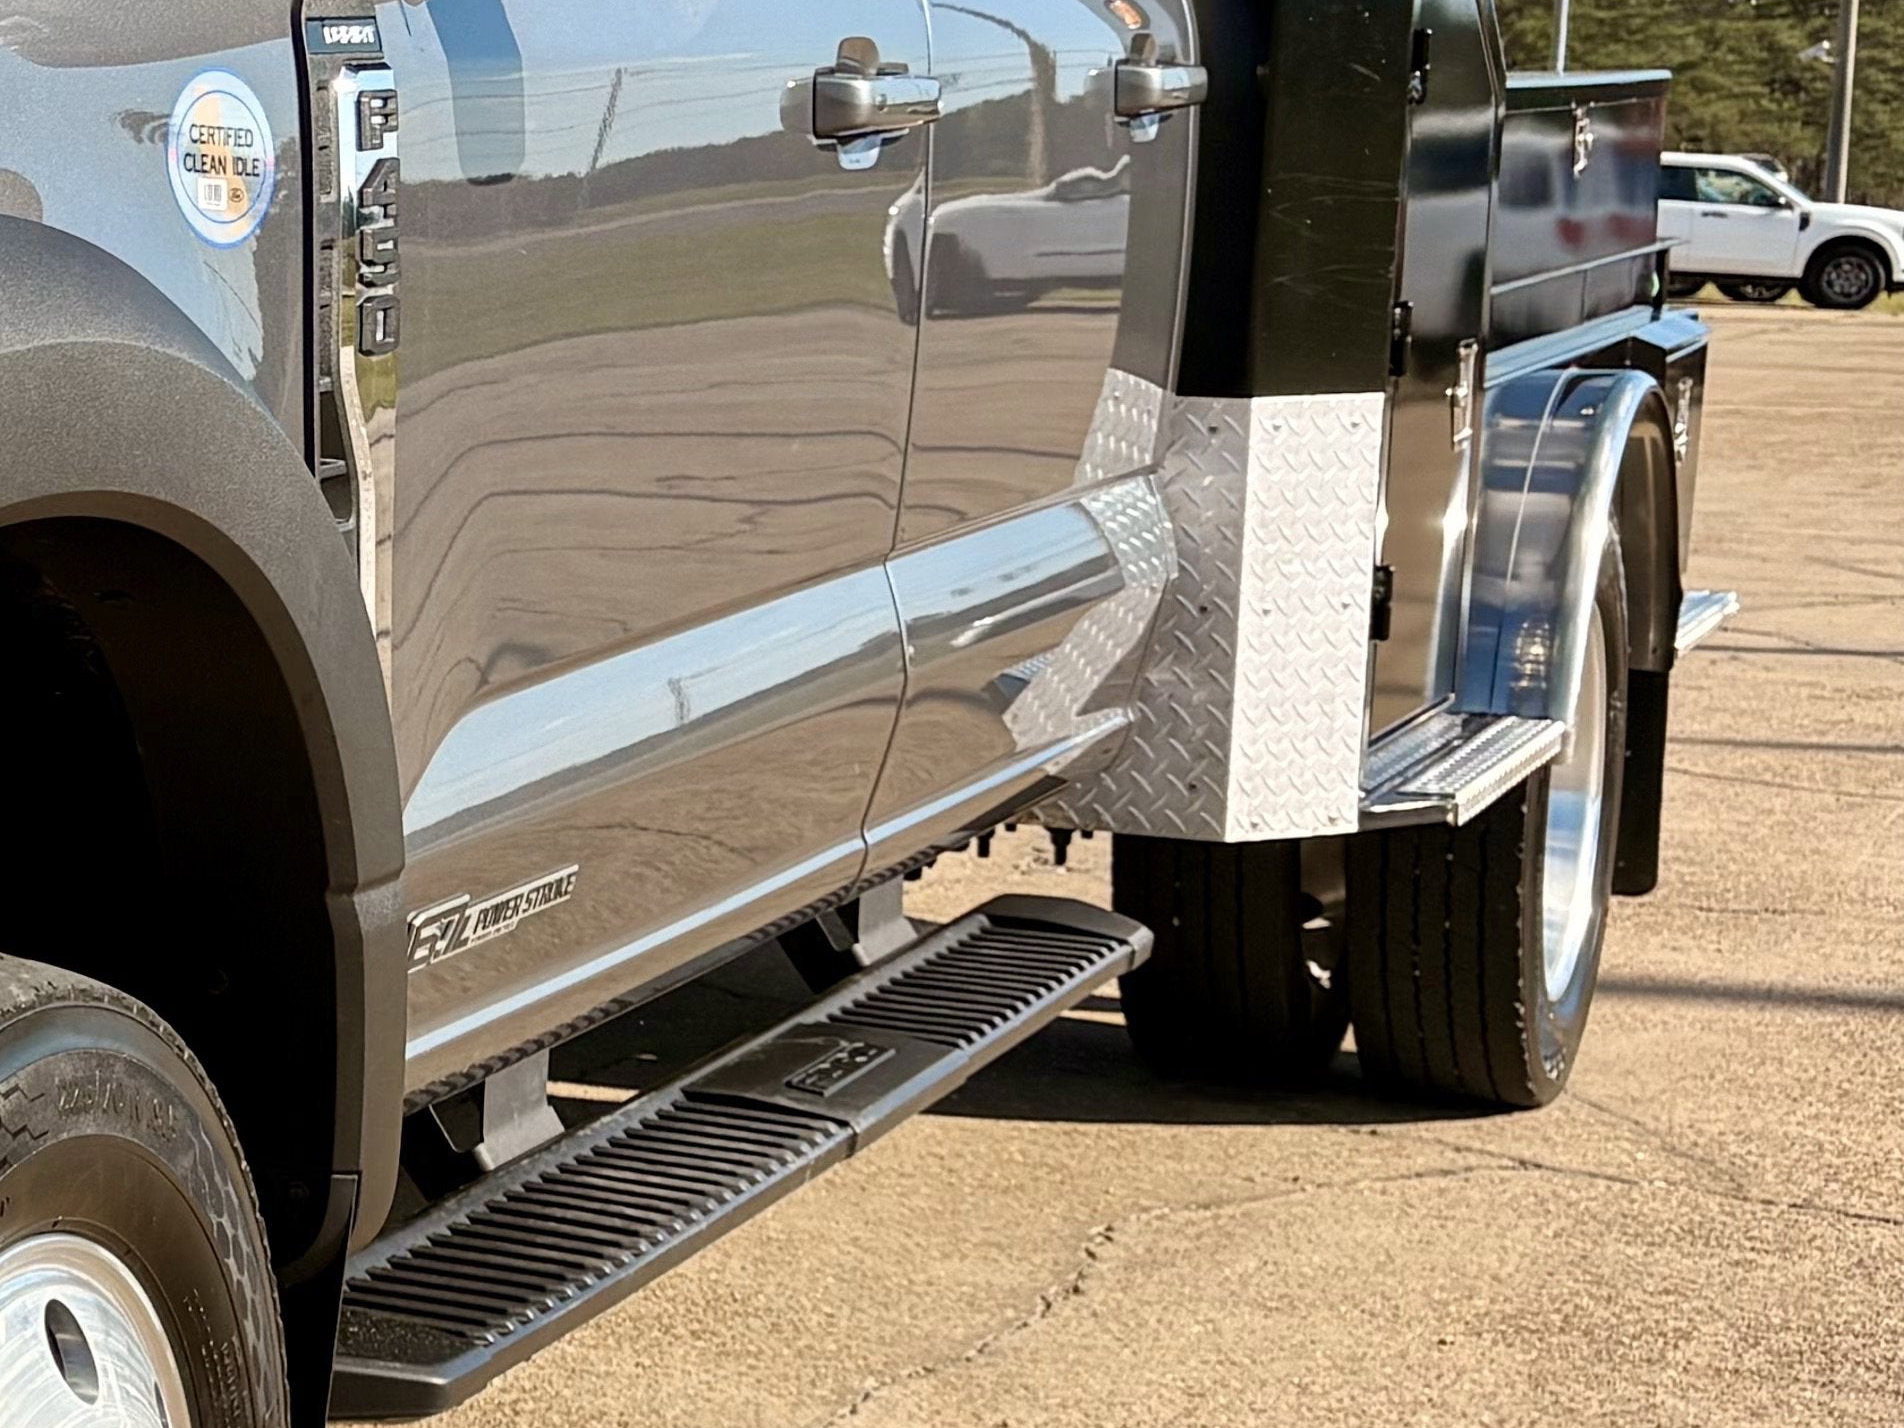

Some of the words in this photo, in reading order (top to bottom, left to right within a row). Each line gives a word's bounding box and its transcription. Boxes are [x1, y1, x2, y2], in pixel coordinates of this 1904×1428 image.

[189, 123, 254, 148] CERTIFIED
[183, 152, 228, 176] CLEAN
[232, 156, 261, 178] IDLE
[472, 892, 525, 935] POWER
